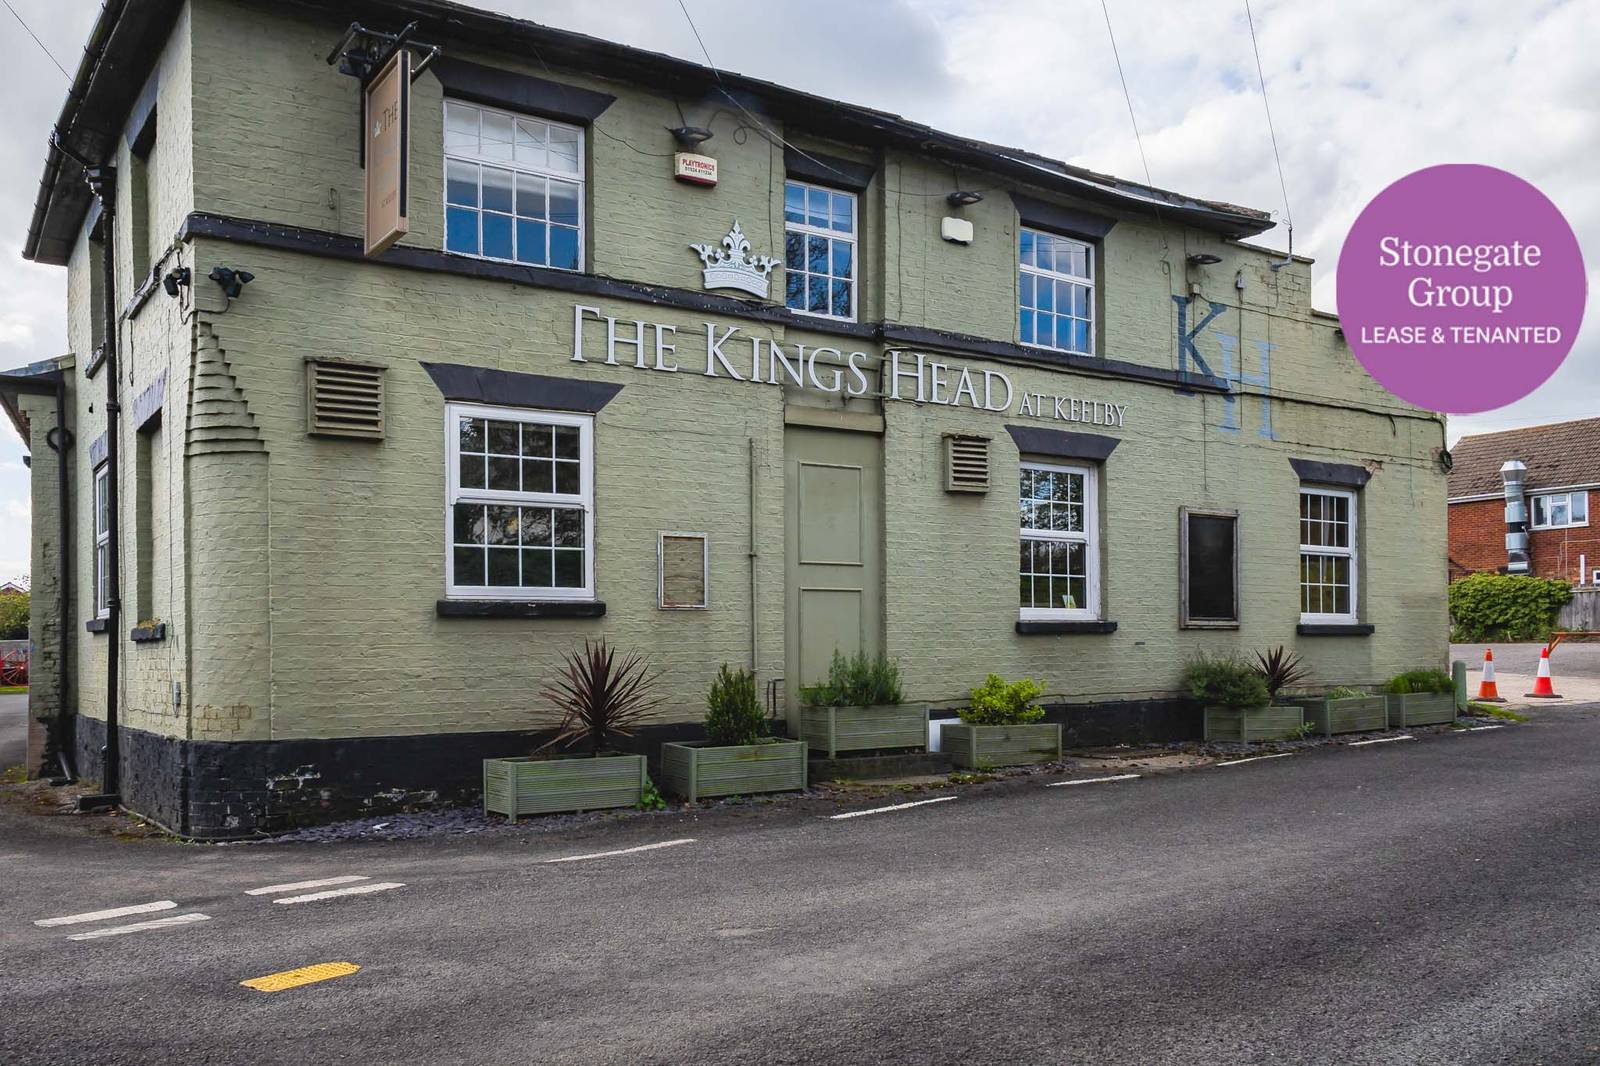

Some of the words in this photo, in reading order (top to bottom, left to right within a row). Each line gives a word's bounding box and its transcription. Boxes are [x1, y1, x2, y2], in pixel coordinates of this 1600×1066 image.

[383, 100, 399, 132] THE
[682, 159, 714, 171] PLAYTRONICS
[570, 303, 679, 373] THE
[703, 321, 868, 396] KINGS
[889, 350, 1014, 413] HEAD
[1017, 391, 1046, 417] AT
[1053, 394, 1129, 428] KEELBY
